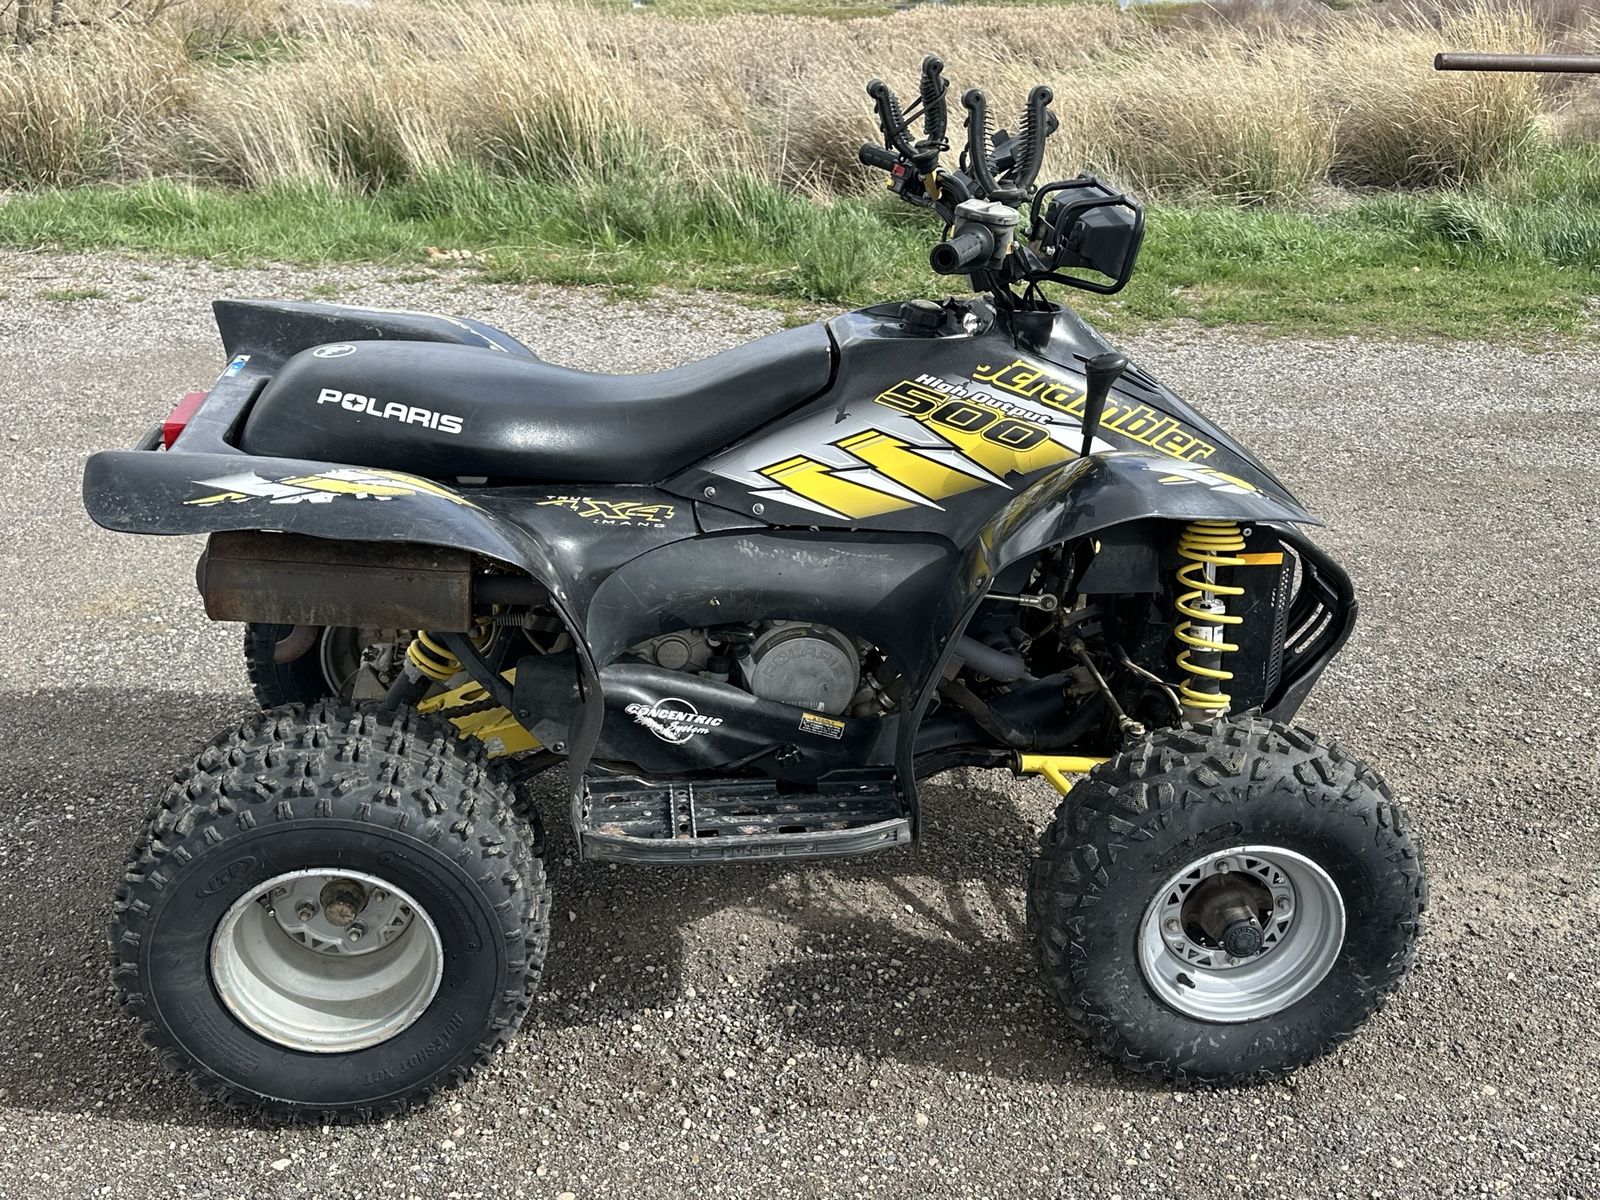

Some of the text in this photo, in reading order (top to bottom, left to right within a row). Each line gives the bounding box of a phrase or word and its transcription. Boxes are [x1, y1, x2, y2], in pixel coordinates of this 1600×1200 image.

[316, 387, 464, 434] POLARIS
[873, 380, 1051, 453] 500
[914, 373, 1053, 426] High Output
[624, 702, 724, 727] CONCENTRIC
[666, 721, 710, 735] System
